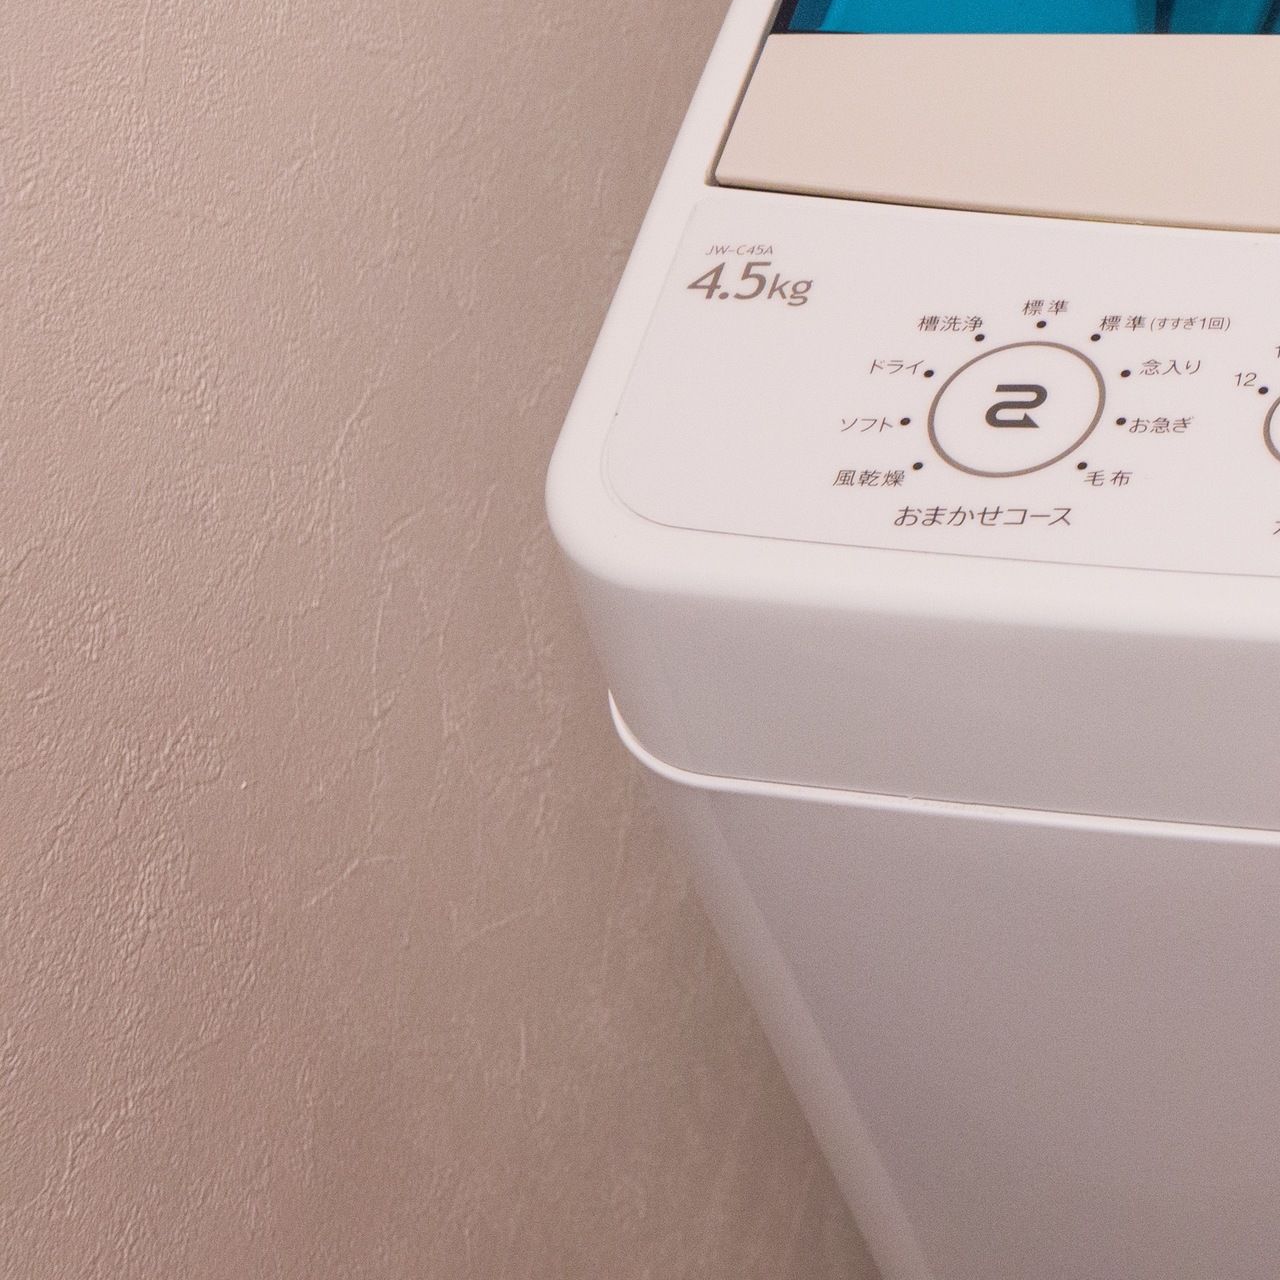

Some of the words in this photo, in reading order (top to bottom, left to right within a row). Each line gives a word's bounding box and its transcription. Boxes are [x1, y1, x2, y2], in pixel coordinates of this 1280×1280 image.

[704, 244, 775, 257] JW-C45A
[687, 261, 815, 307] 4.5kg
[1023, 299, 1070, 316] 標準
[918, 315, 984, 332] 槽洗浄
[867, 358, 924, 376] ドライ
[1140, 359, 1202, 376] 念入り
[1233, 372, 1258, 388] 12
[839, 416, 894, 433] ソフト
[1129, 416, 1193, 434] お急ぎ
[833, 469, 906, 487] 風乾燥
[1082, 469, 1134, 488] 毛布
[894, 505, 1073, 527] おまかせコース
